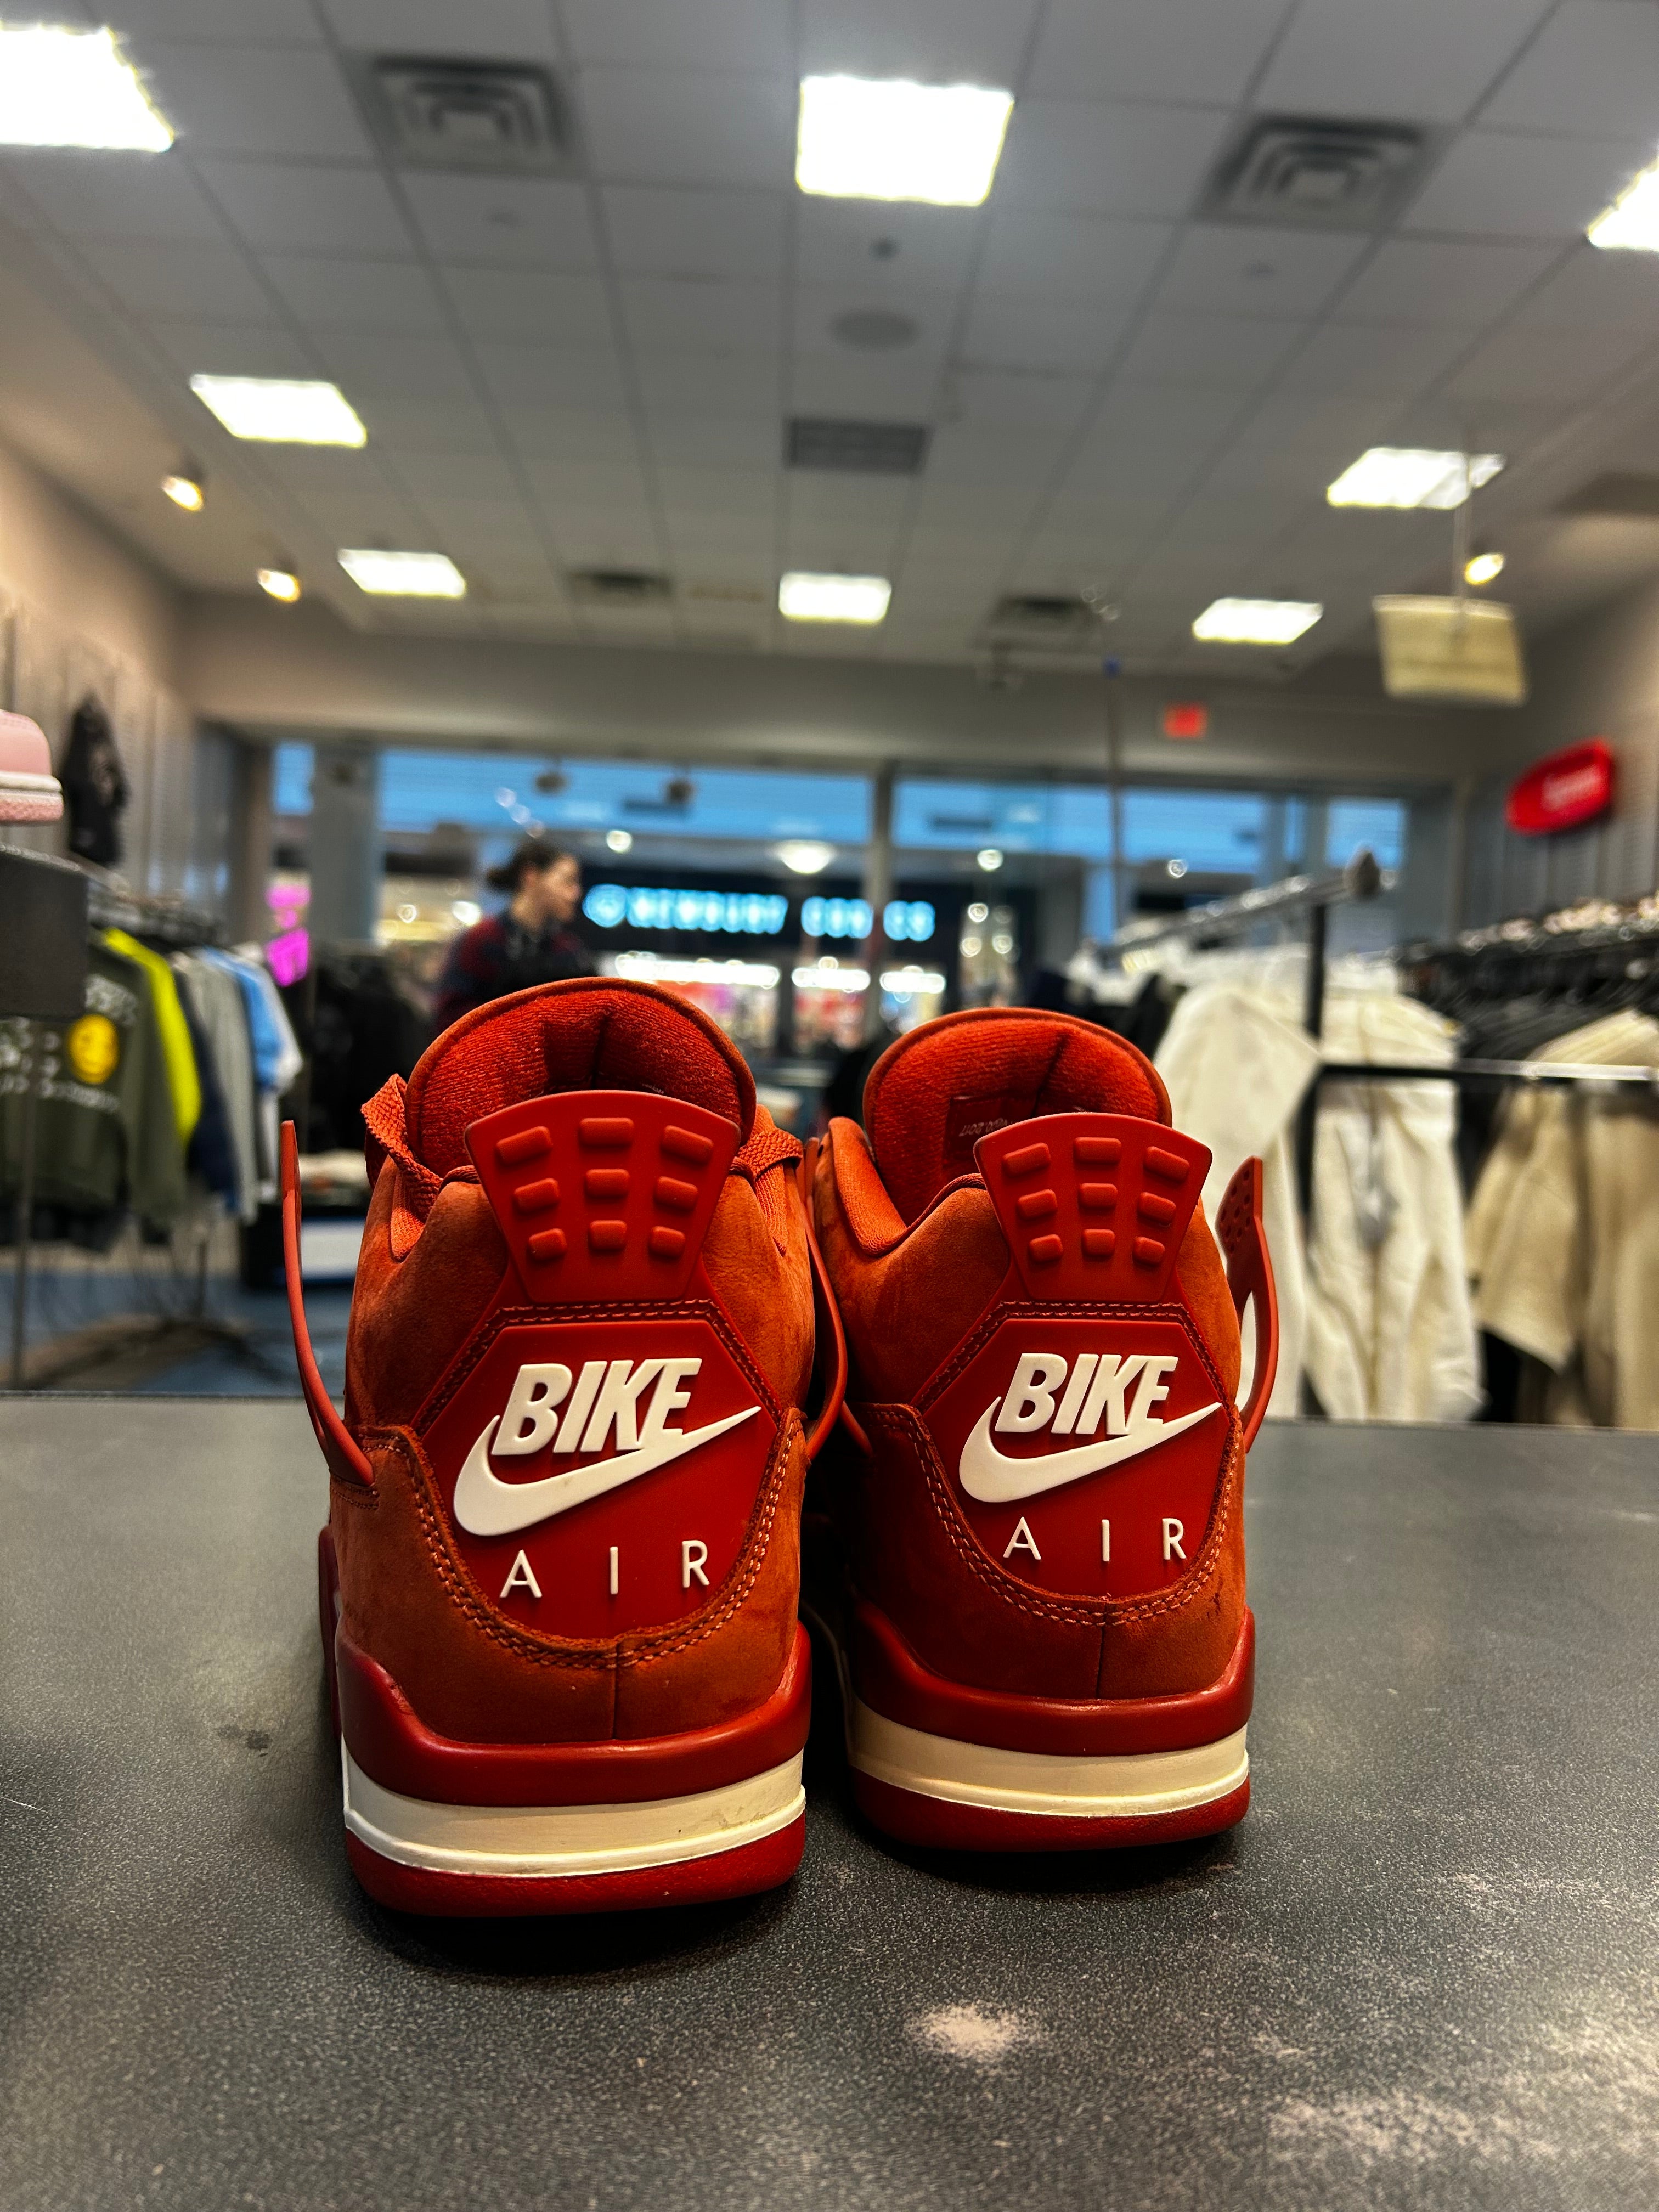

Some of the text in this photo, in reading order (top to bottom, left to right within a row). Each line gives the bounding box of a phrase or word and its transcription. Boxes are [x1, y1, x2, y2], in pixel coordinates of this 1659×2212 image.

[491, 1357, 703, 1456] BIKE
[994, 1352, 1179, 1435] BIKE
[499, 1539, 710, 1599] AIR
[1002, 1516, 1187, 1562] AIR
